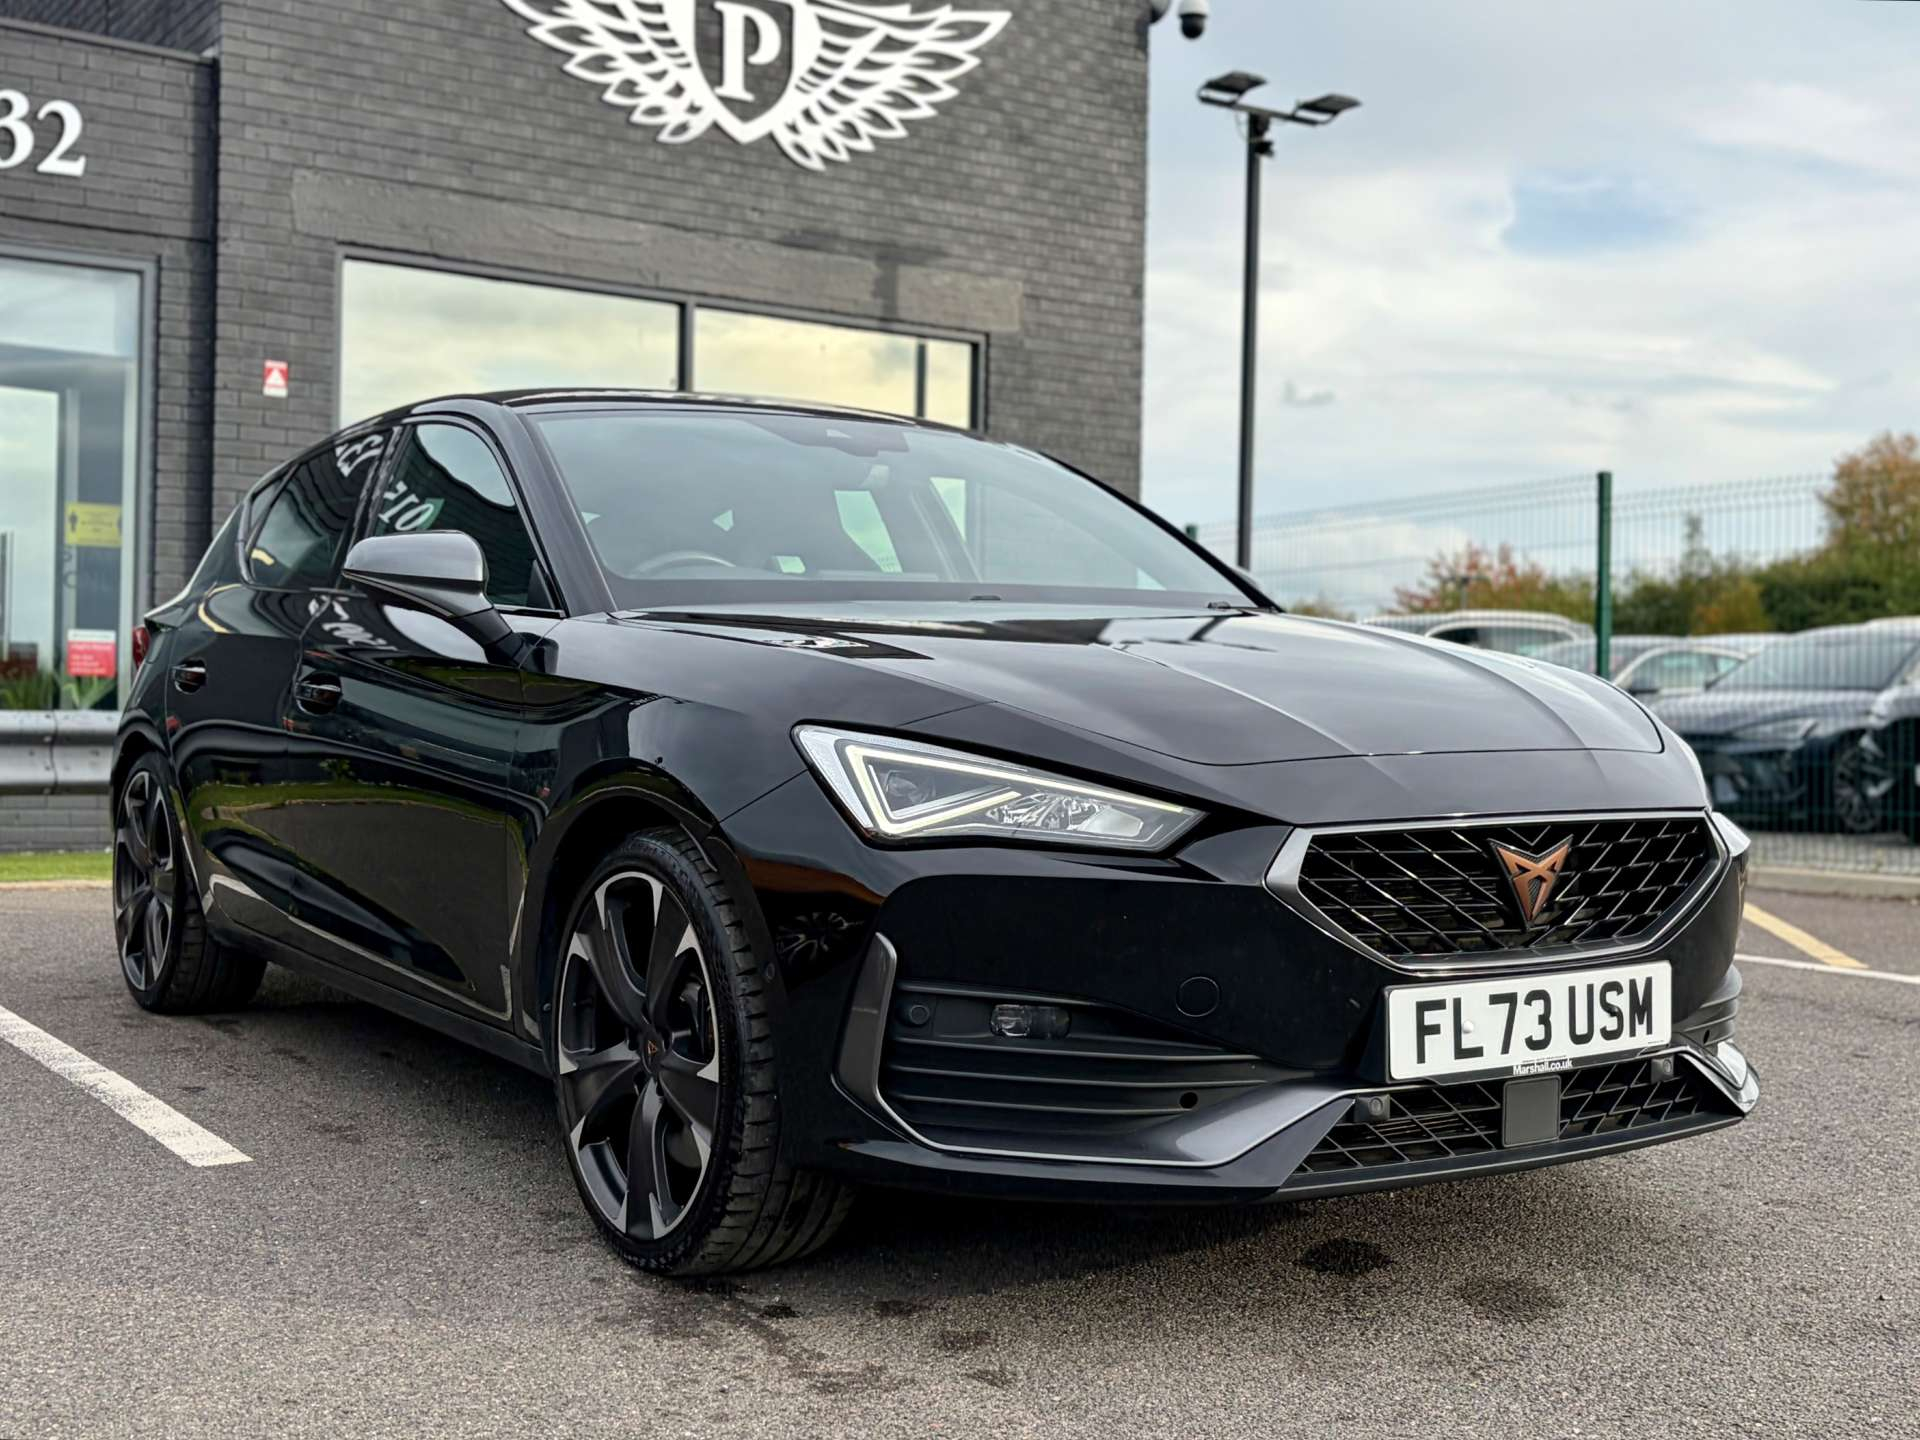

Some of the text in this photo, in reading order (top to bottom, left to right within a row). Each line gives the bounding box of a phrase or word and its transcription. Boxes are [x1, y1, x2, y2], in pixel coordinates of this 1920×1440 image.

[713, 1, 782, 102] P
[1415, 976, 1653, 1065] FL73 USM
[1512, 1057, 1573, 1076] Marshall.co.uk
